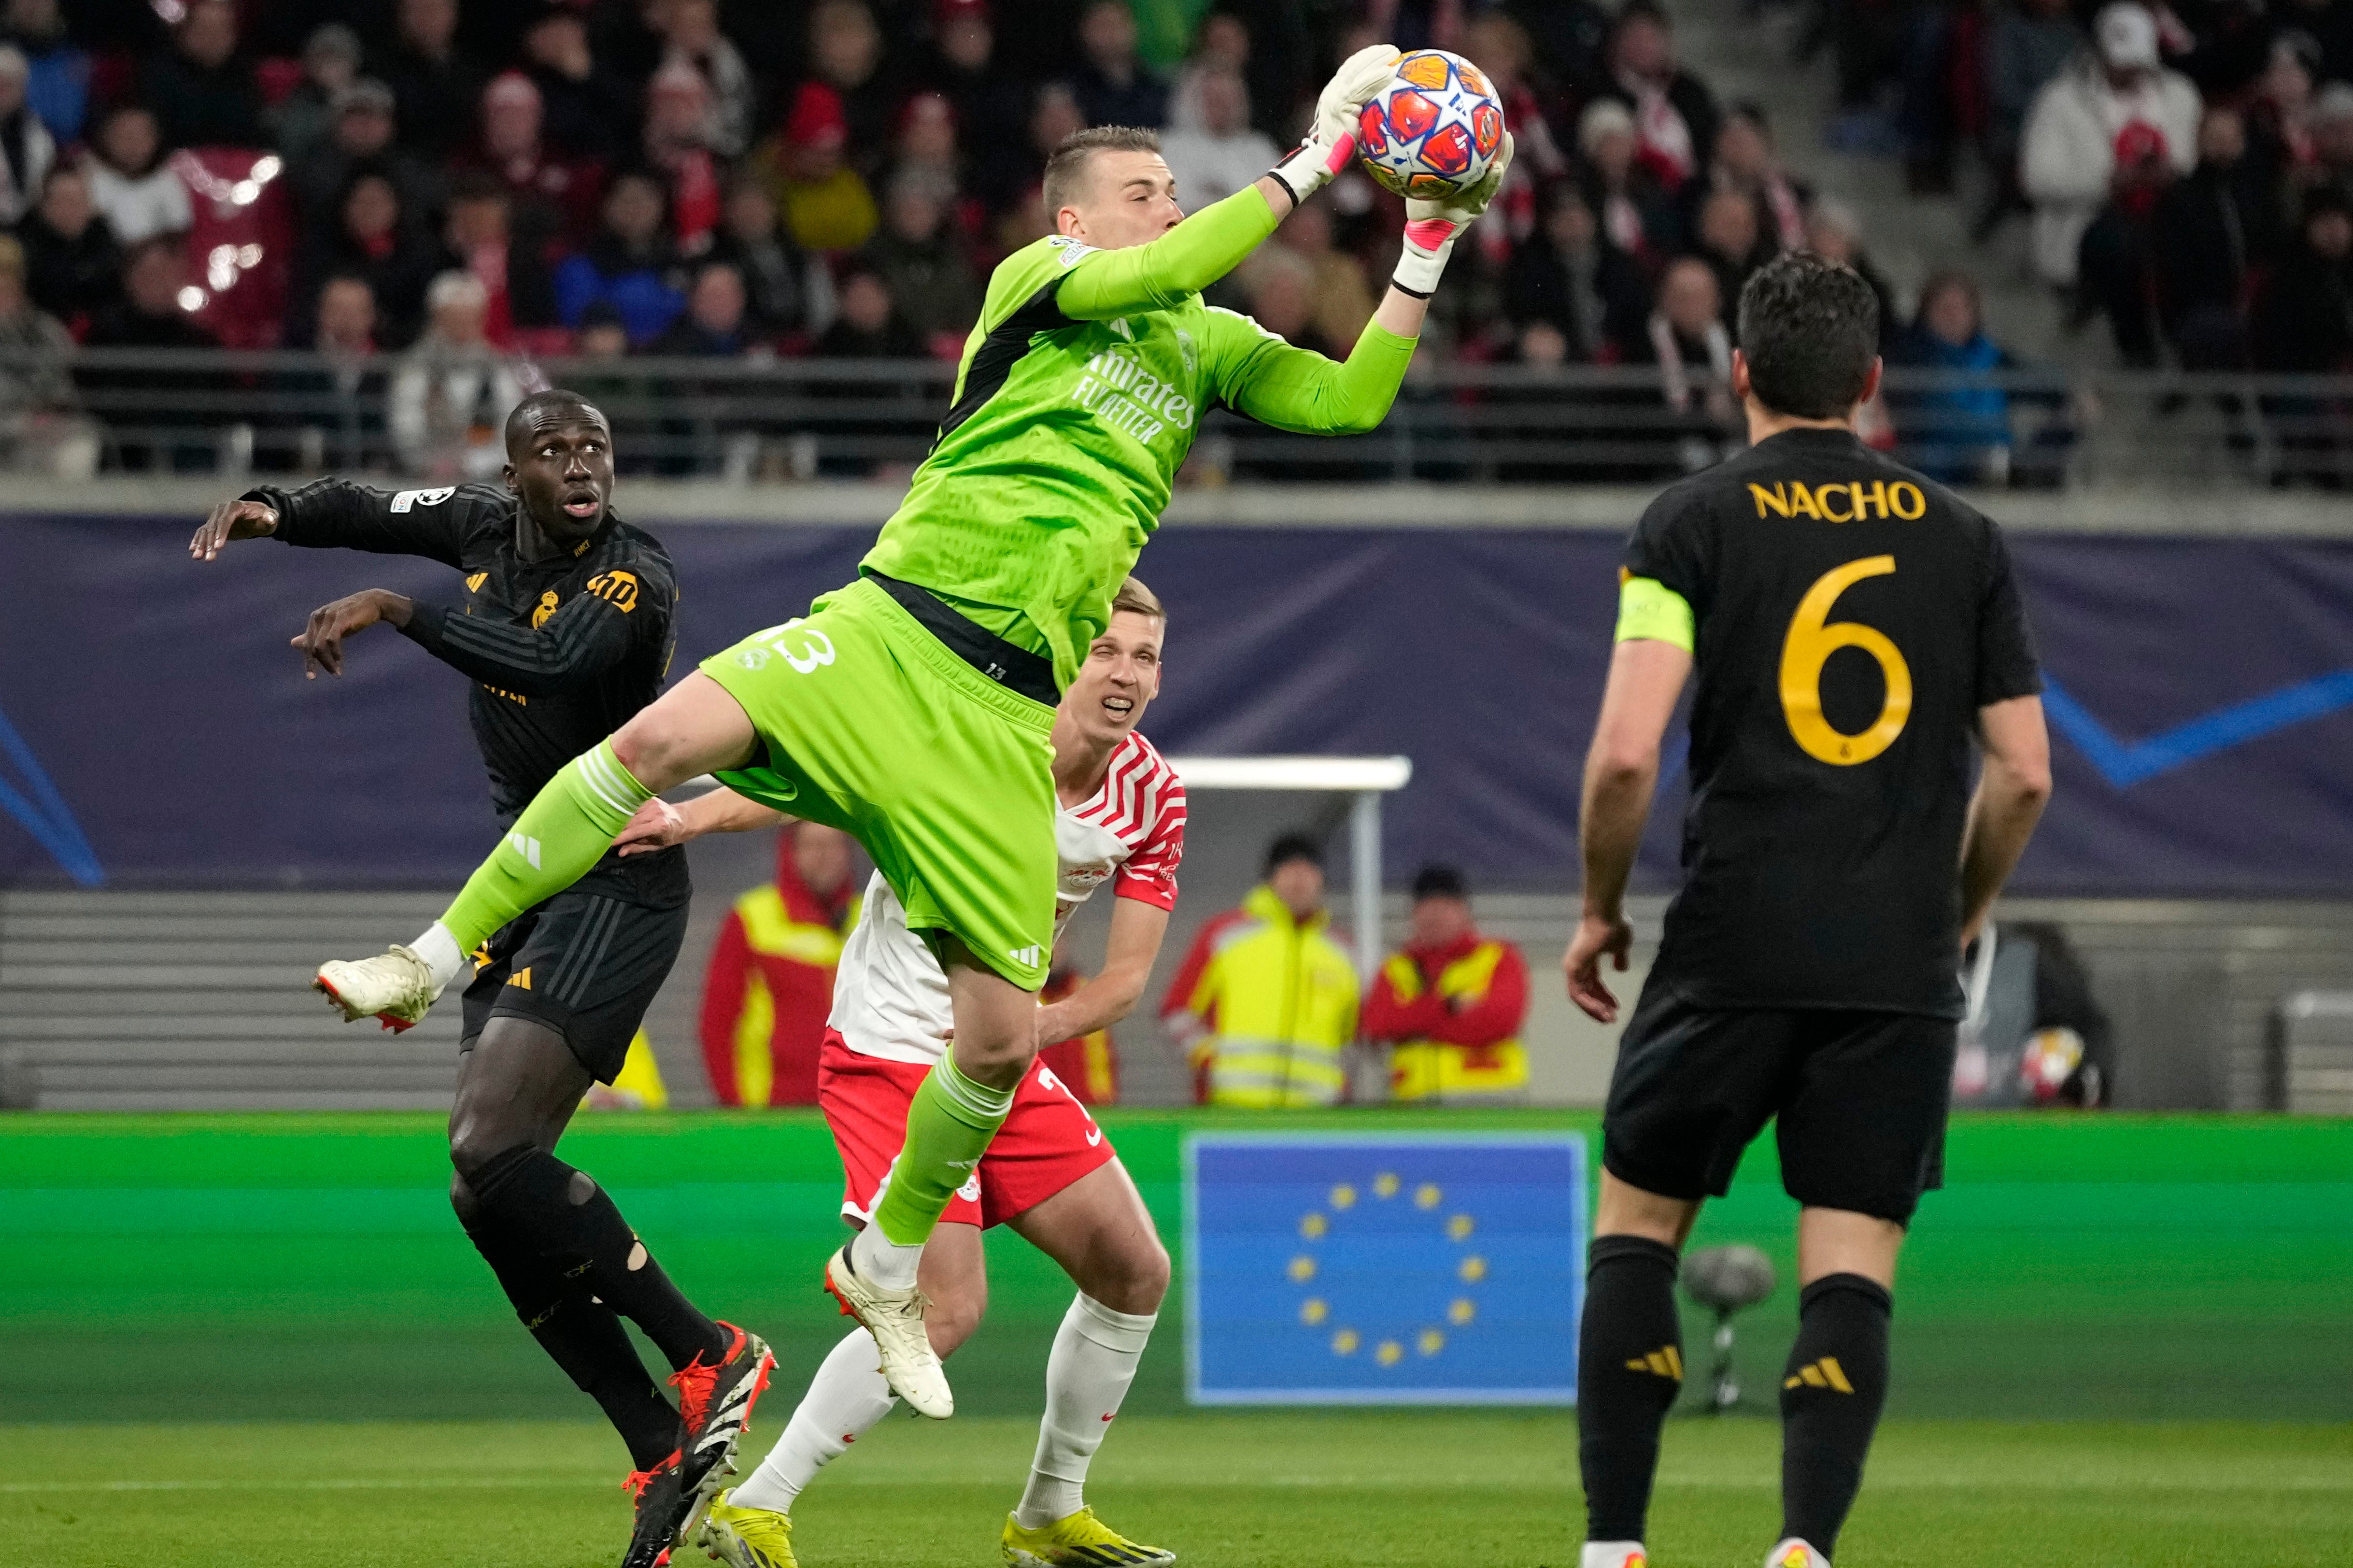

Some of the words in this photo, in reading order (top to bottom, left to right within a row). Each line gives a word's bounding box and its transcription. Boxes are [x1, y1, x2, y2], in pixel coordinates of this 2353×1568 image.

[1071, 376, 1110, 408] FLY
[1097, 393, 1164, 445] BETTER
[1089, 350, 1194, 430] mirates
[1747, 480, 1926, 523] NACHO
[755, 617, 835, 674] 13
[985, 662, 1007, 680] 13
[1778, 554, 1913, 766] 6
